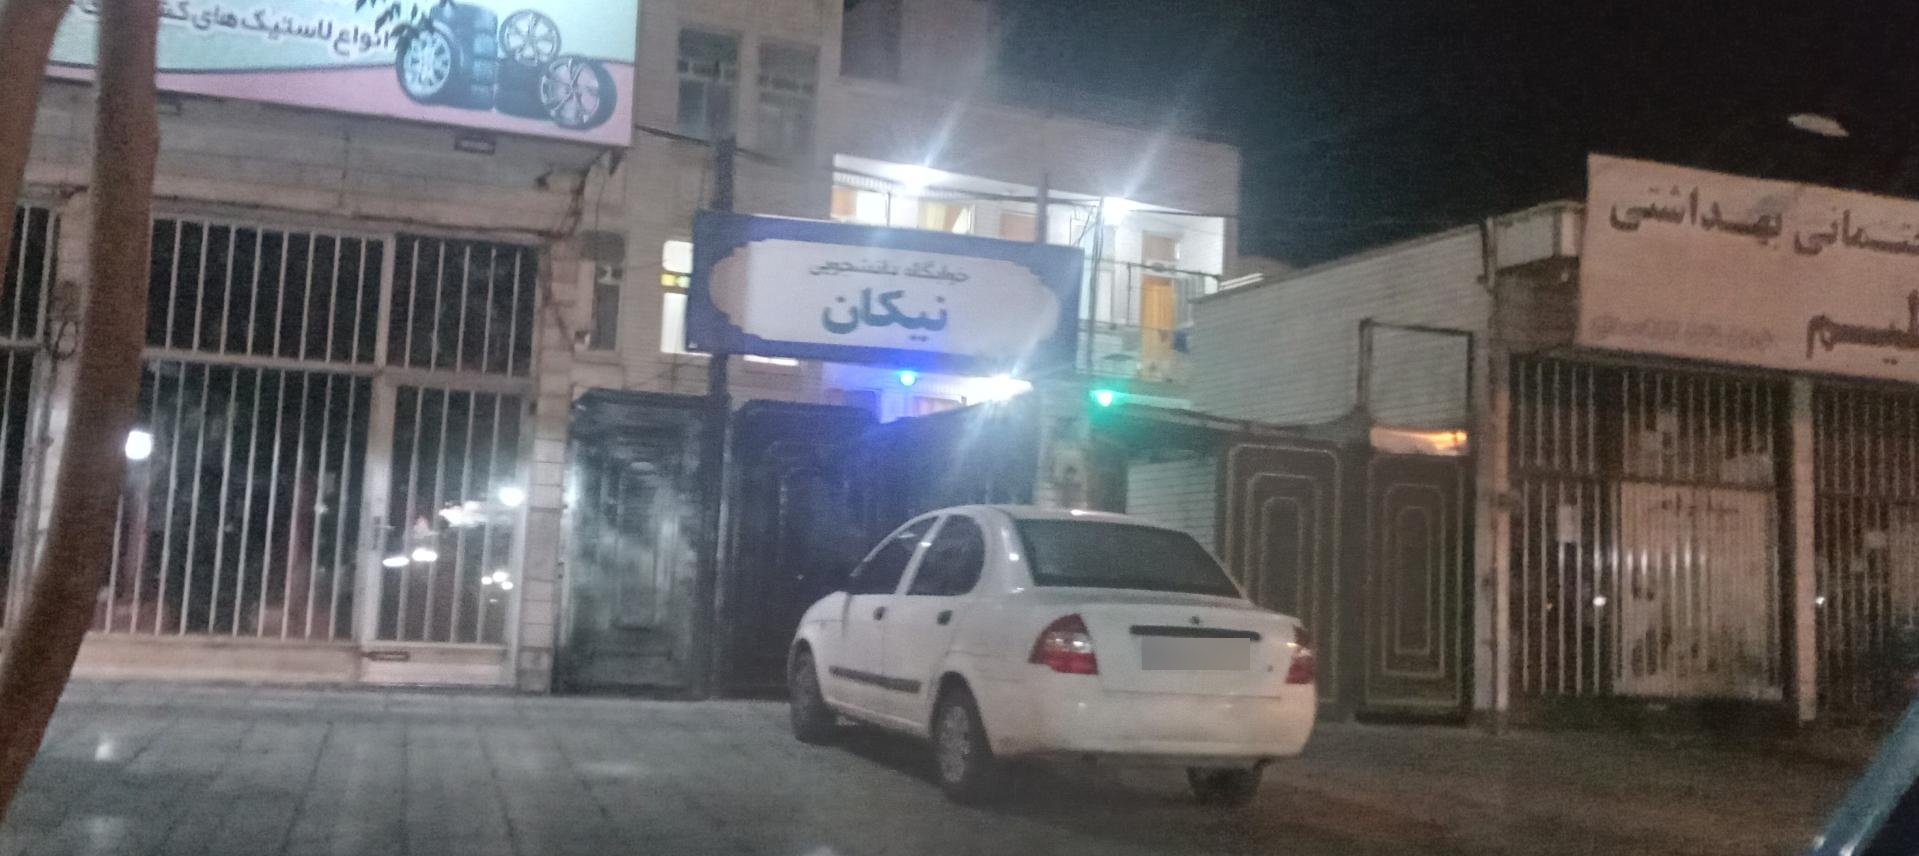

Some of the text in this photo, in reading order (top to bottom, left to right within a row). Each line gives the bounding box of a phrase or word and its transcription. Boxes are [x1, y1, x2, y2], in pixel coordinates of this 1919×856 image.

[332, 26, 390, 56] انواع
[1609, 184, 1919, 256] تمانی بهداشتی
[819, 286, 948, 342] نیکان
[1805, 288, 1919, 366] لیم
